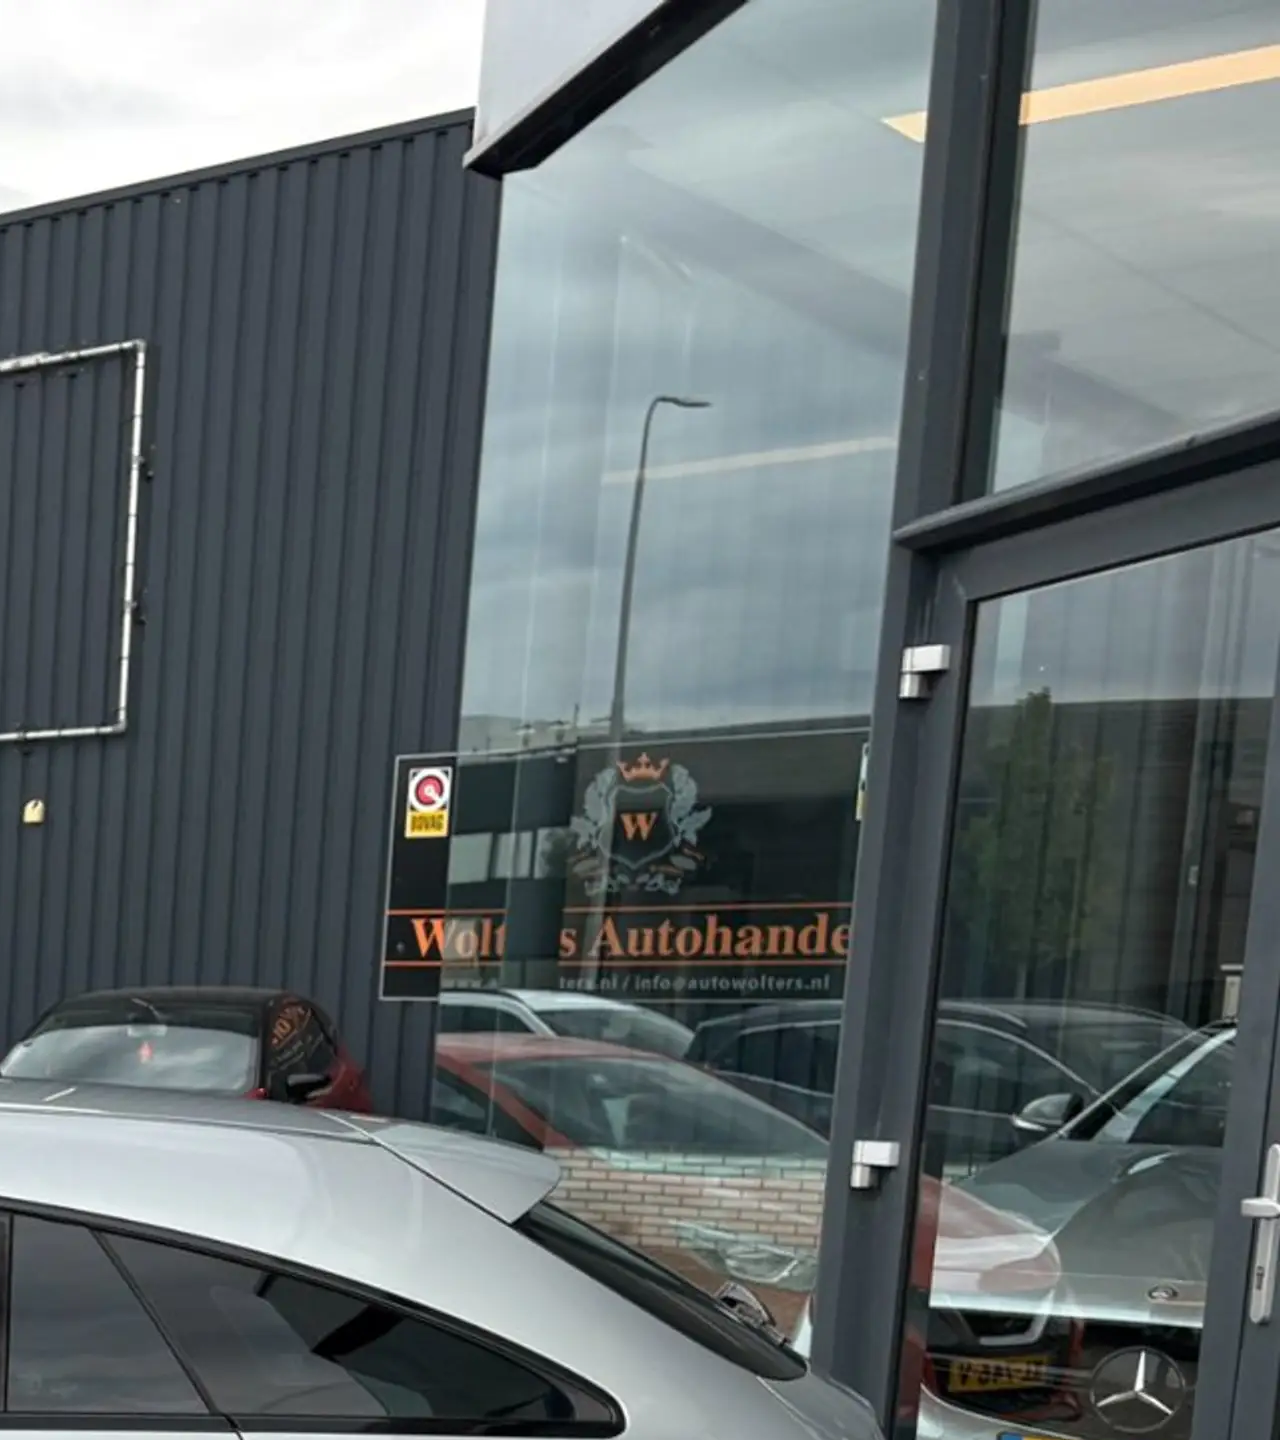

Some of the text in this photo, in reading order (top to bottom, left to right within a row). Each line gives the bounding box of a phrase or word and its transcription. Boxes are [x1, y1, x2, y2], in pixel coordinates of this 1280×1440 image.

[620, 812, 657, 841] W
[411, 911, 852, 958] Wolts Autohande
